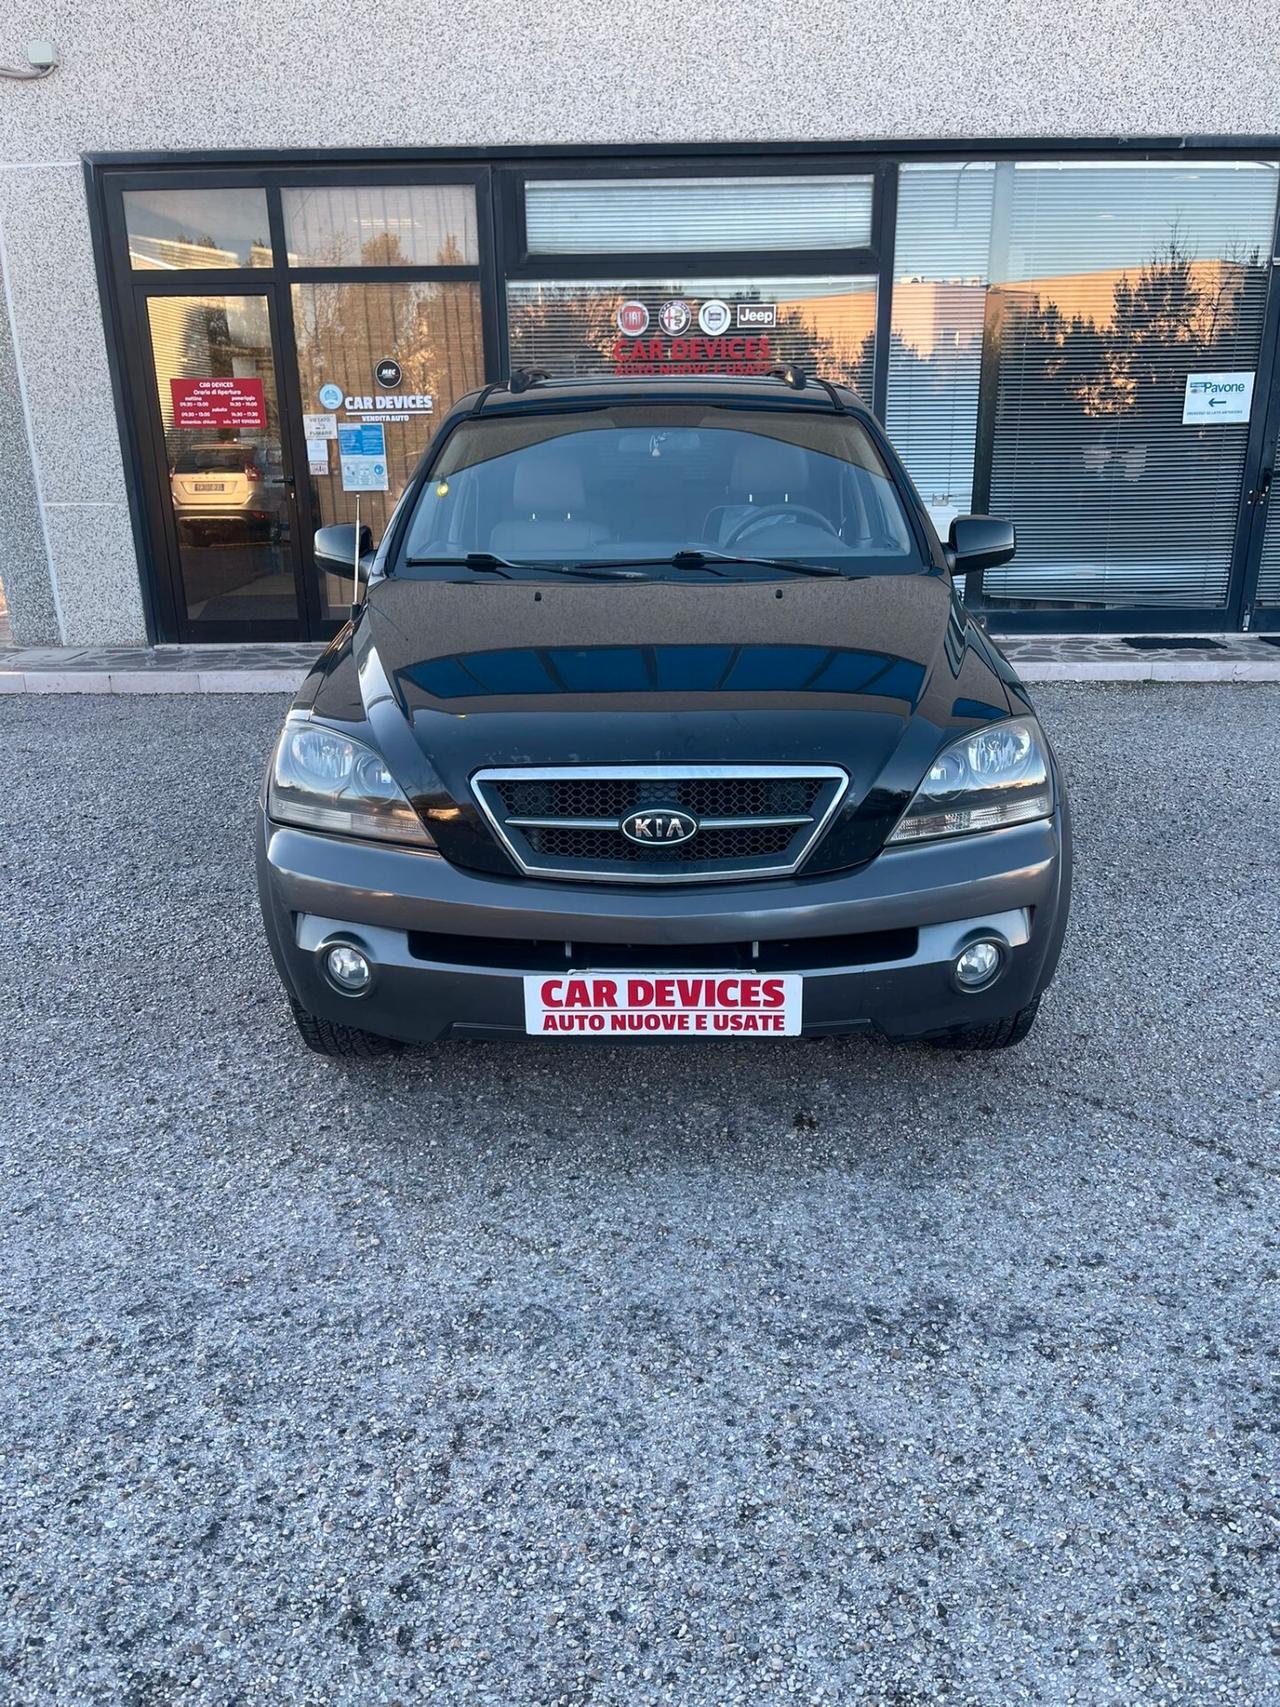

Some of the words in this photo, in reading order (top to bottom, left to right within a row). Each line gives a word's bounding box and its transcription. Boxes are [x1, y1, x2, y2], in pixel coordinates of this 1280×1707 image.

[624, 312, 641, 325] FIAT
[740, 309, 773, 323] Jeep
[614, 339, 664, 361] CAR
[670, 337, 770, 360] DEVICES
[1204, 382, 1245, 393] Pavone
[345, 396, 374, 409] CAR
[375, 395, 433, 409] DEVICES
[634, 818, 685, 837] KIA
[541, 979, 618, 1008] CAR
[628, 979, 785, 1008] DEVICES
[543, 1014, 605, 1031] AUTO
[611, 1014, 689, 1031] NUOVE
[695, 1015, 707, 1031] E
[713, 1014, 785, 1031] USATE
